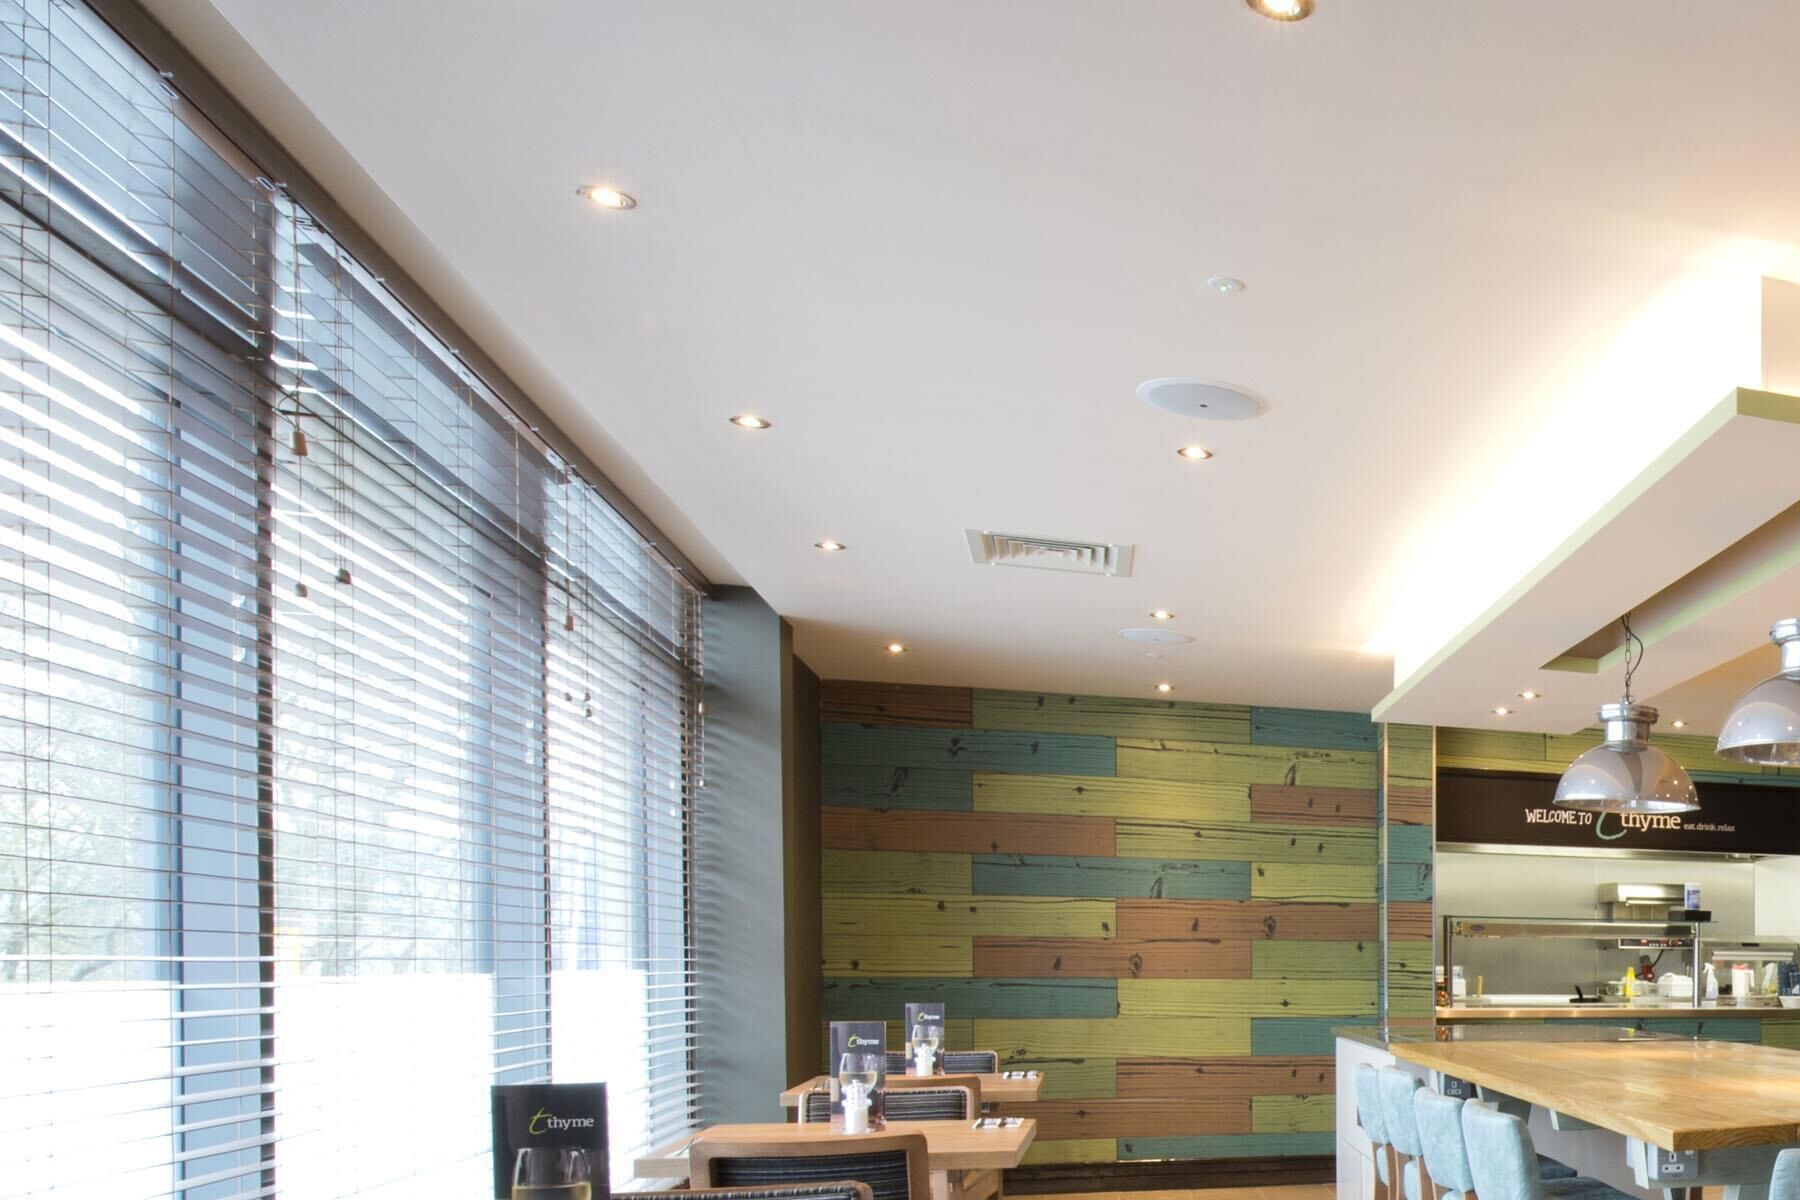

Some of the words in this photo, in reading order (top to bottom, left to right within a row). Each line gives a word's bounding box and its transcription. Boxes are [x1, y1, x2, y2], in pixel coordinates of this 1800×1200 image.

[1525, 809, 1577, 824] WELCOME
[1578, 812, 1592, 825] TO
[1620, 812, 1681, 832] thyme
[1683, 823, 1736, 832] eat.drink.relax
[547, 1116, 594, 1130] thyme
